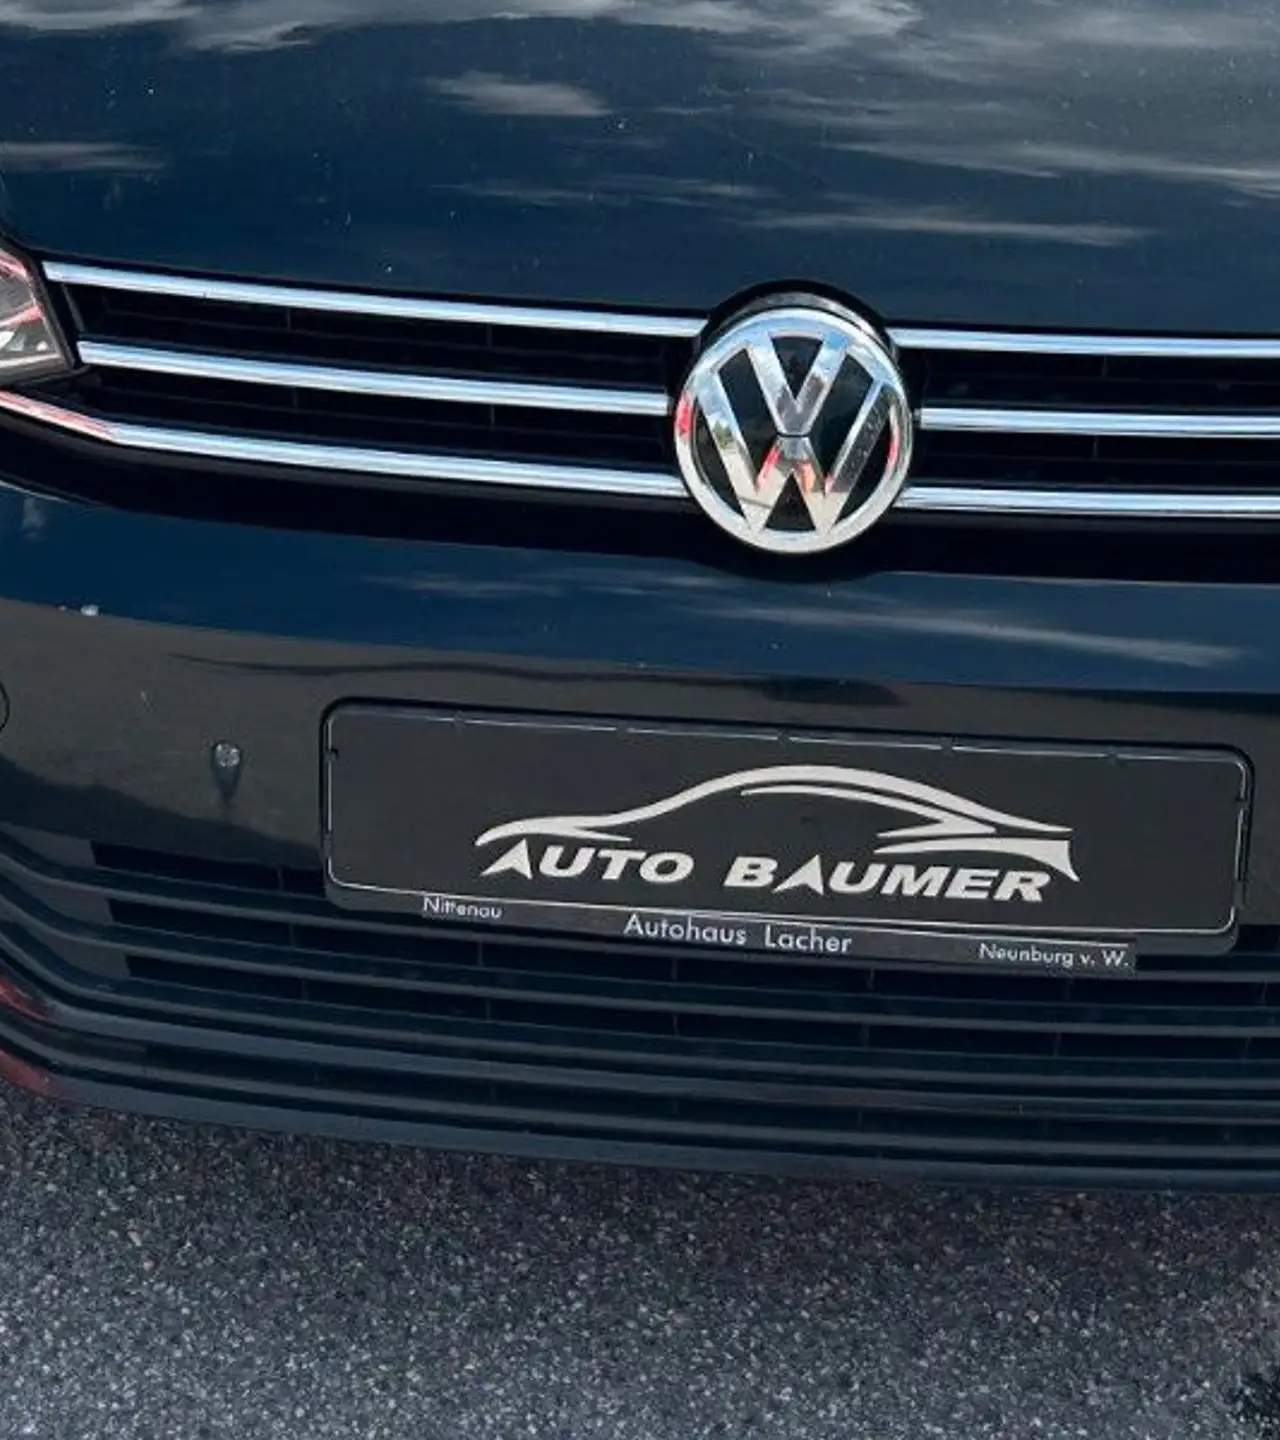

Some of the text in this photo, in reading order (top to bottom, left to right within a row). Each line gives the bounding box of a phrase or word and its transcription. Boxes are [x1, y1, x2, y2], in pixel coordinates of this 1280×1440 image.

[479, 838, 1051, 902] AUTO BAUMER
[422, 895, 503, 919] Nittenau
[622, 913, 853, 954] Autohaus Lacher
[978, 942, 1074, 968] Neunburg
[1101, 949, 1129, 967] W.
